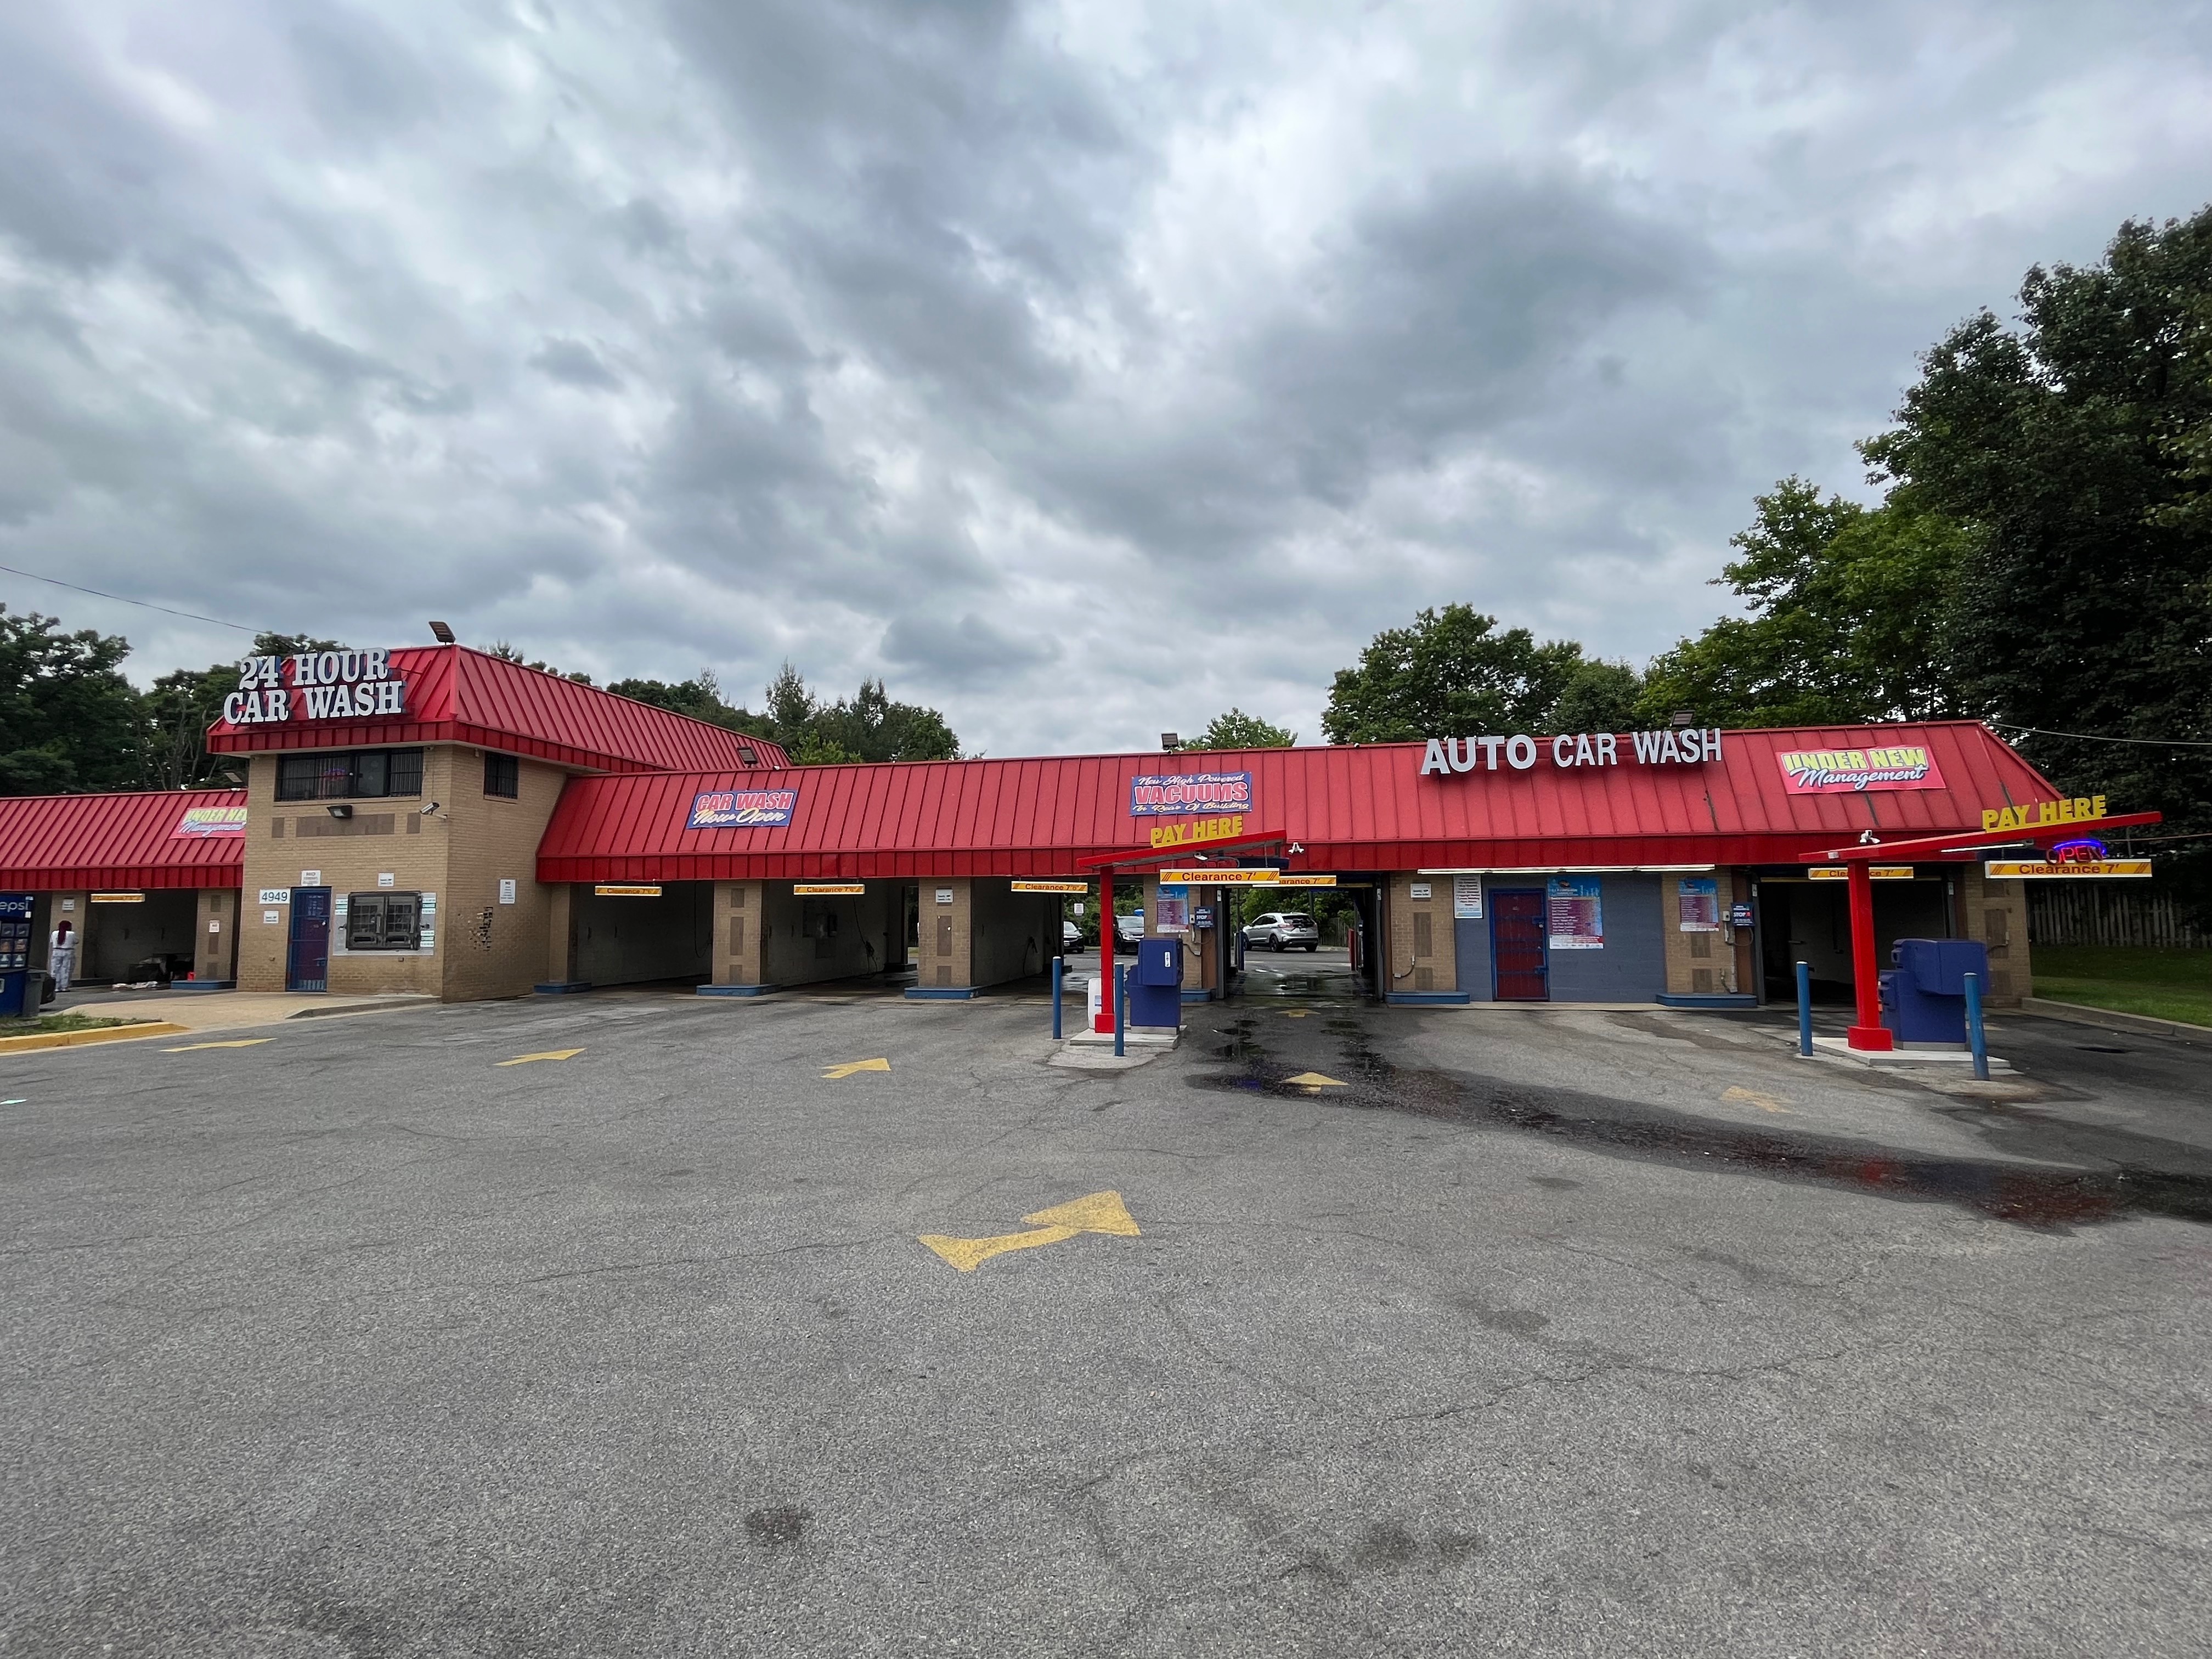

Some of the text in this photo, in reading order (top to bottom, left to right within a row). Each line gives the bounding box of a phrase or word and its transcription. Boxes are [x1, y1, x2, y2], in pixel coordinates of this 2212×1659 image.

[239, 647, 388, 690] 24 HOUR
[223, 680, 403, 724] CAR WASH
[1419, 728, 1722, 775] AUTO CAR WASH
[1781, 747, 1929, 772] UNDER NEW
[1138, 774, 1245, 786] New High Powered
[1789, 764, 1929, 790] Management
[695, 792, 794, 812] CAR WASH
[1134, 782, 1249, 804] VACUUMS
[224, 807, 248, 822] NE
[693, 807, 787, 825] Now Open
[1152, 804, 1181, 812] Rear
[1185, 803, 1200, 811] Of
[1202, 802, 1250, 810] Building
[1982, 794, 2107, 830] PAY HERE
[1150, 815, 1243, 845] PAY HERE
[2046, 845, 2106, 865] OPEN
[1182, 872, 1256, 881] Clearance 7'
[2019, 864, 2120, 874] Clearance 7'
[0, 900, 29, 912] epsi
[262, 891, 288, 902] 4949
